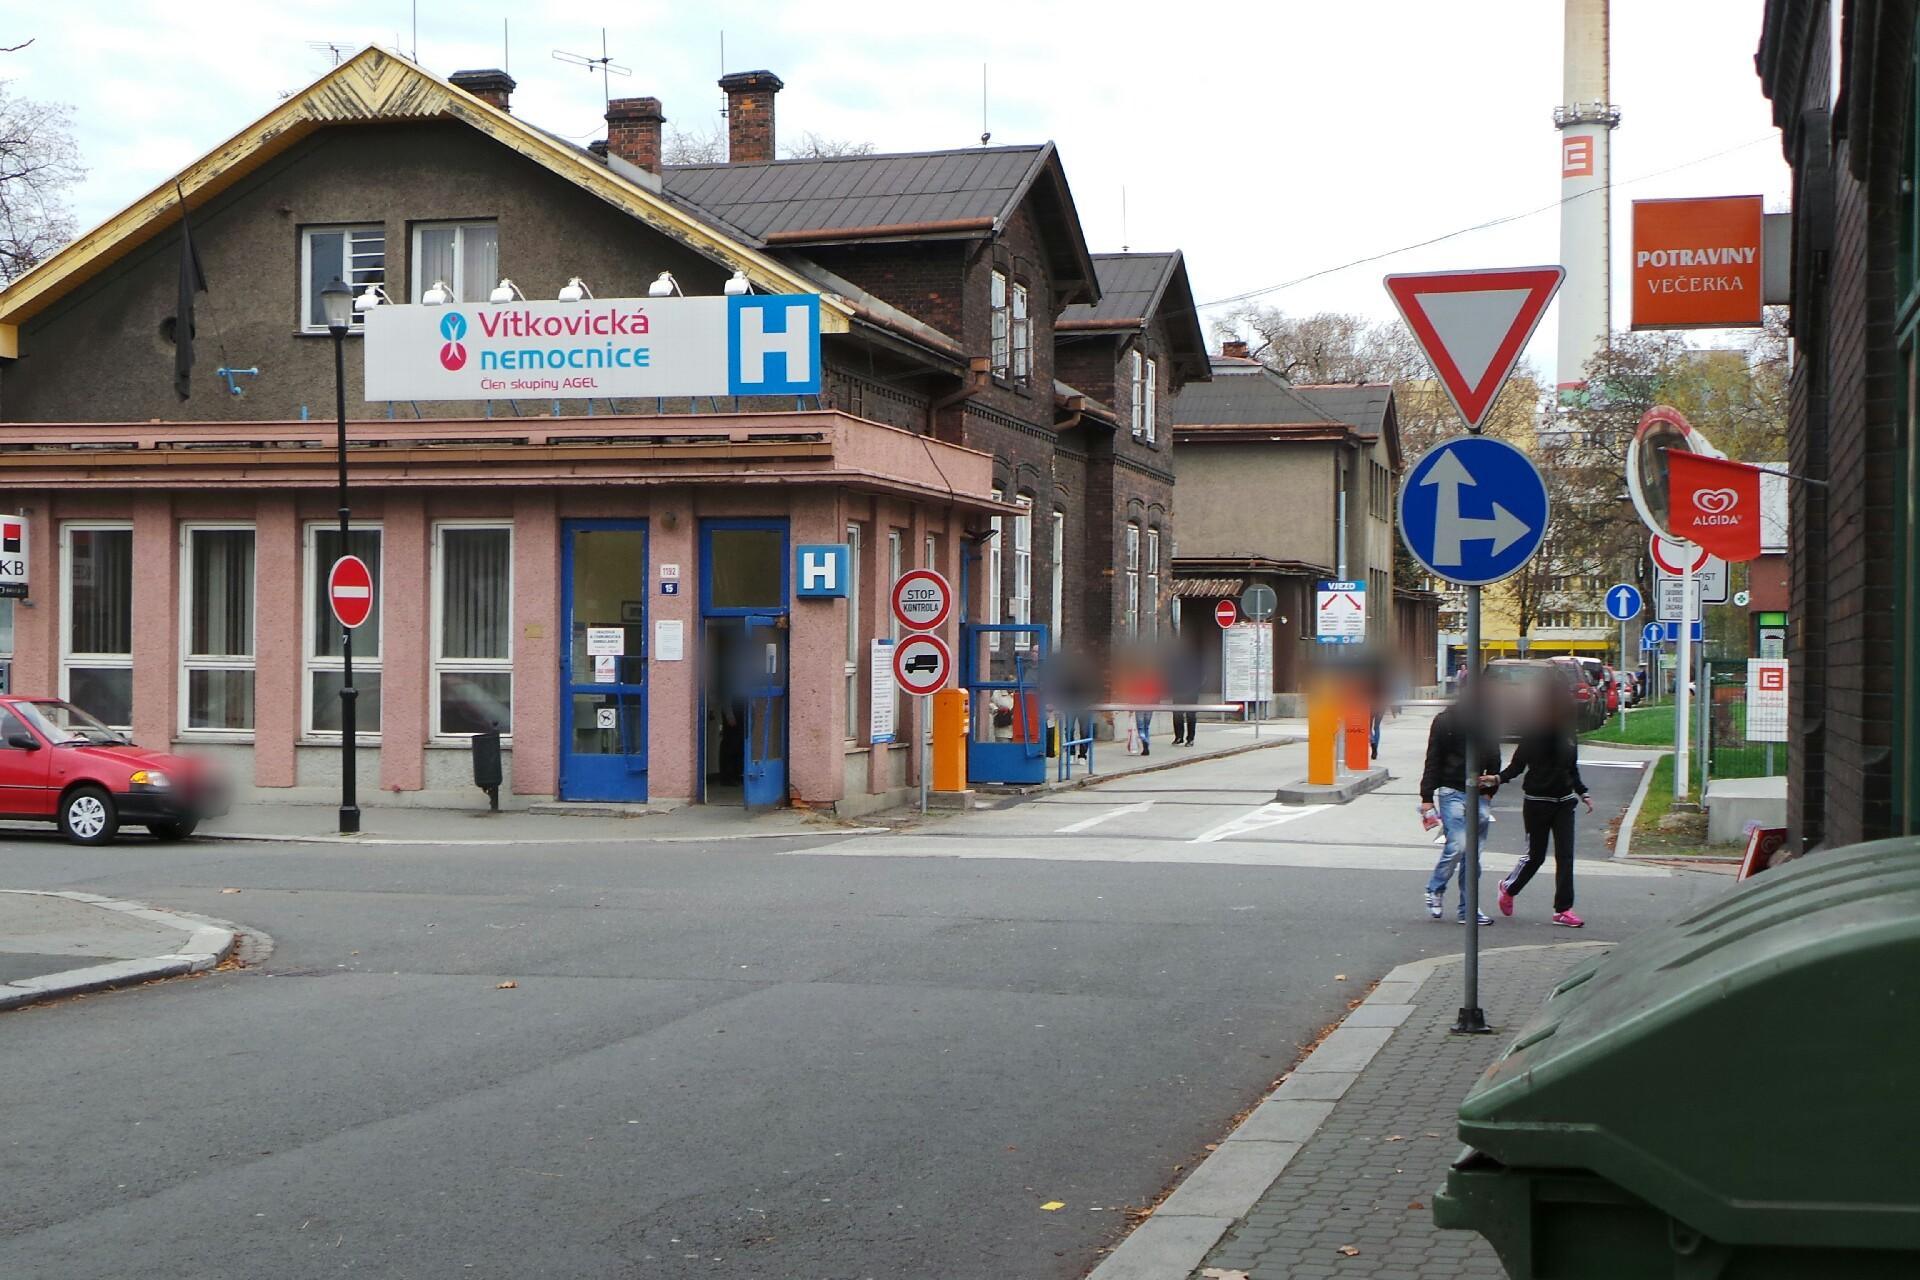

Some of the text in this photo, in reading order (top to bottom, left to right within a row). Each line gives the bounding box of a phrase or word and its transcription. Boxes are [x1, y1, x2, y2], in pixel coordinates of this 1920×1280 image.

[1637, 247, 1756, 268] POTRAVINY
[1648, 275, 1743, 294] VEČERKA
[478, 307, 649, 337] Vítkovická
[739, 305, 810, 384] H
[480, 342, 650, 370] nemocnice
[481, 377, 598, 391] Člen skupiny AGEL
[1693, 515, 1739, 526] ALGIDA
[803, 552, 836, 589] H
[907, 589, 935, 600] STOP
[903, 603, 939, 613] KONTROLA
